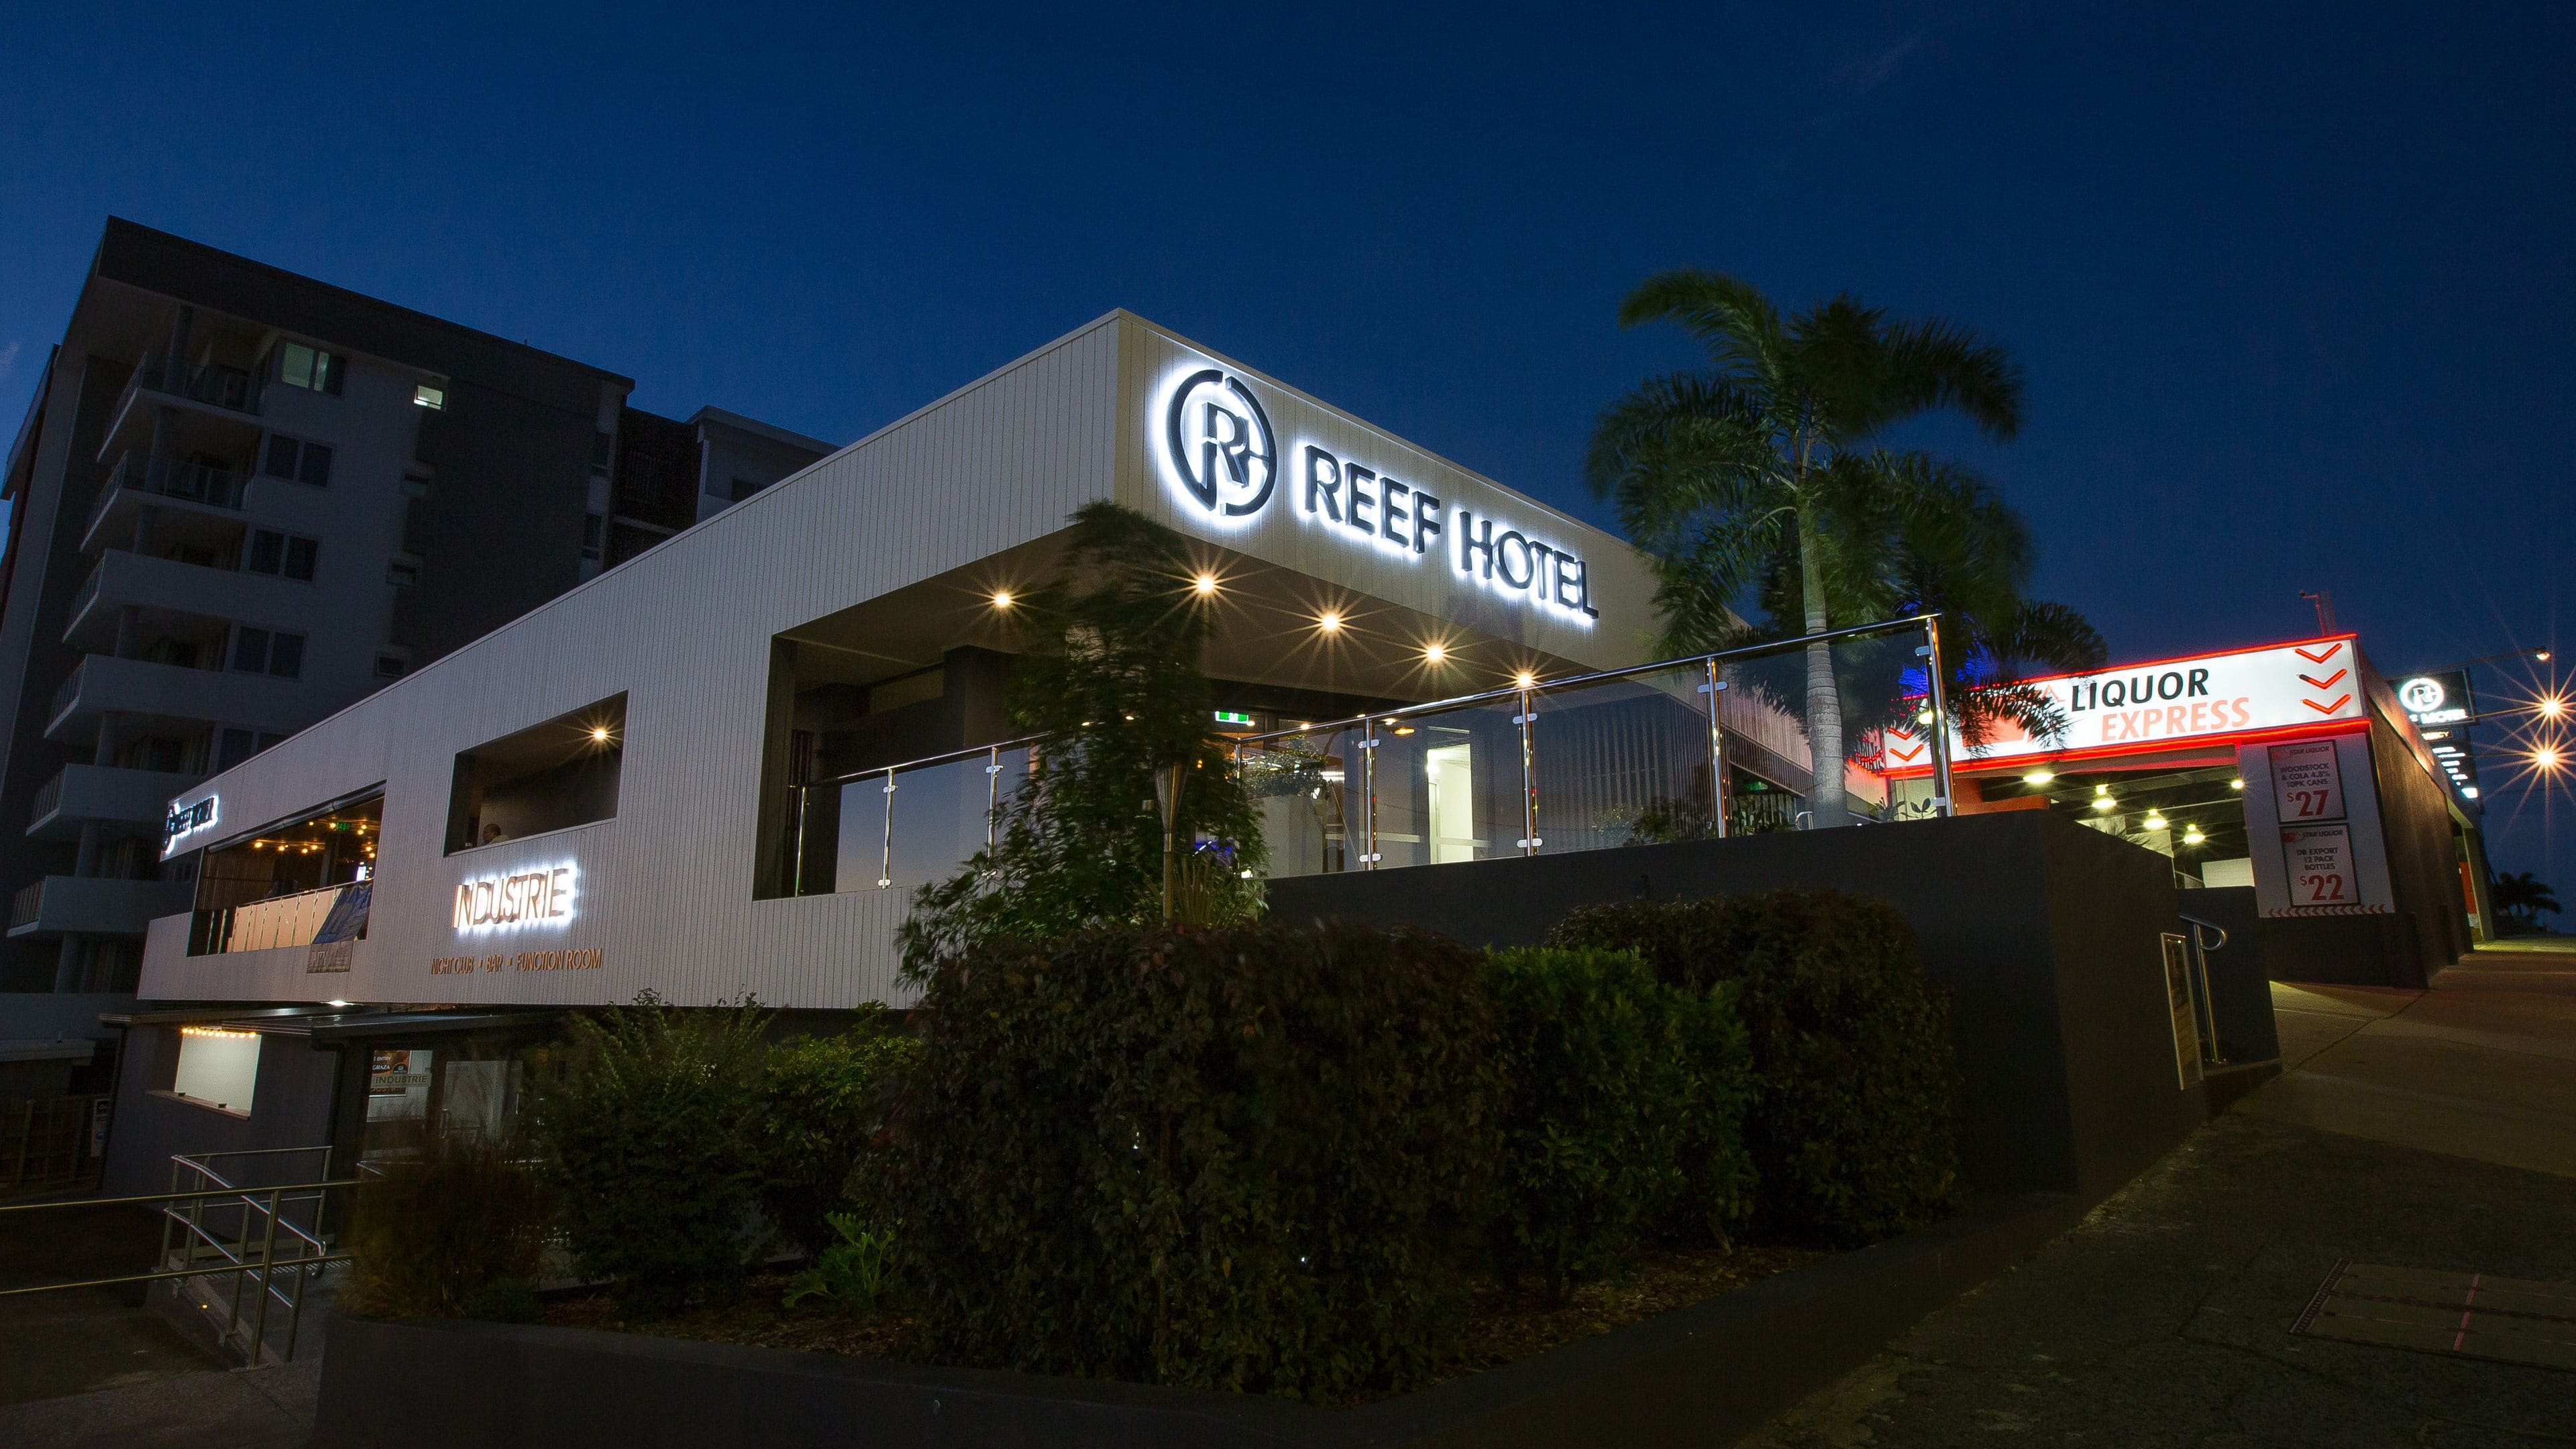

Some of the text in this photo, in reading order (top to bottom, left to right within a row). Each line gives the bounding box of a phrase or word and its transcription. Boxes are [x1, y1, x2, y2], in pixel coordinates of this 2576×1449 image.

[1303, 444, 1599, 620] REEF HOTEL
[2071, 668, 2208, 712] LIQUOR
[2101, 698, 2250, 742] EXPRESS
[2279, 763, 2329, 773] WOODSTOCK
[2307, 778, 2328, 786] CANS
[2304, 863, 2335, 871] BOTTLES
[451, 868, 569, 928] INDUSTRIE
[431, 946, 602, 975] NIGHT CLUB BAR FUNCTION ROOM
[376, 1075, 428, 1084] INDUSTRIE
